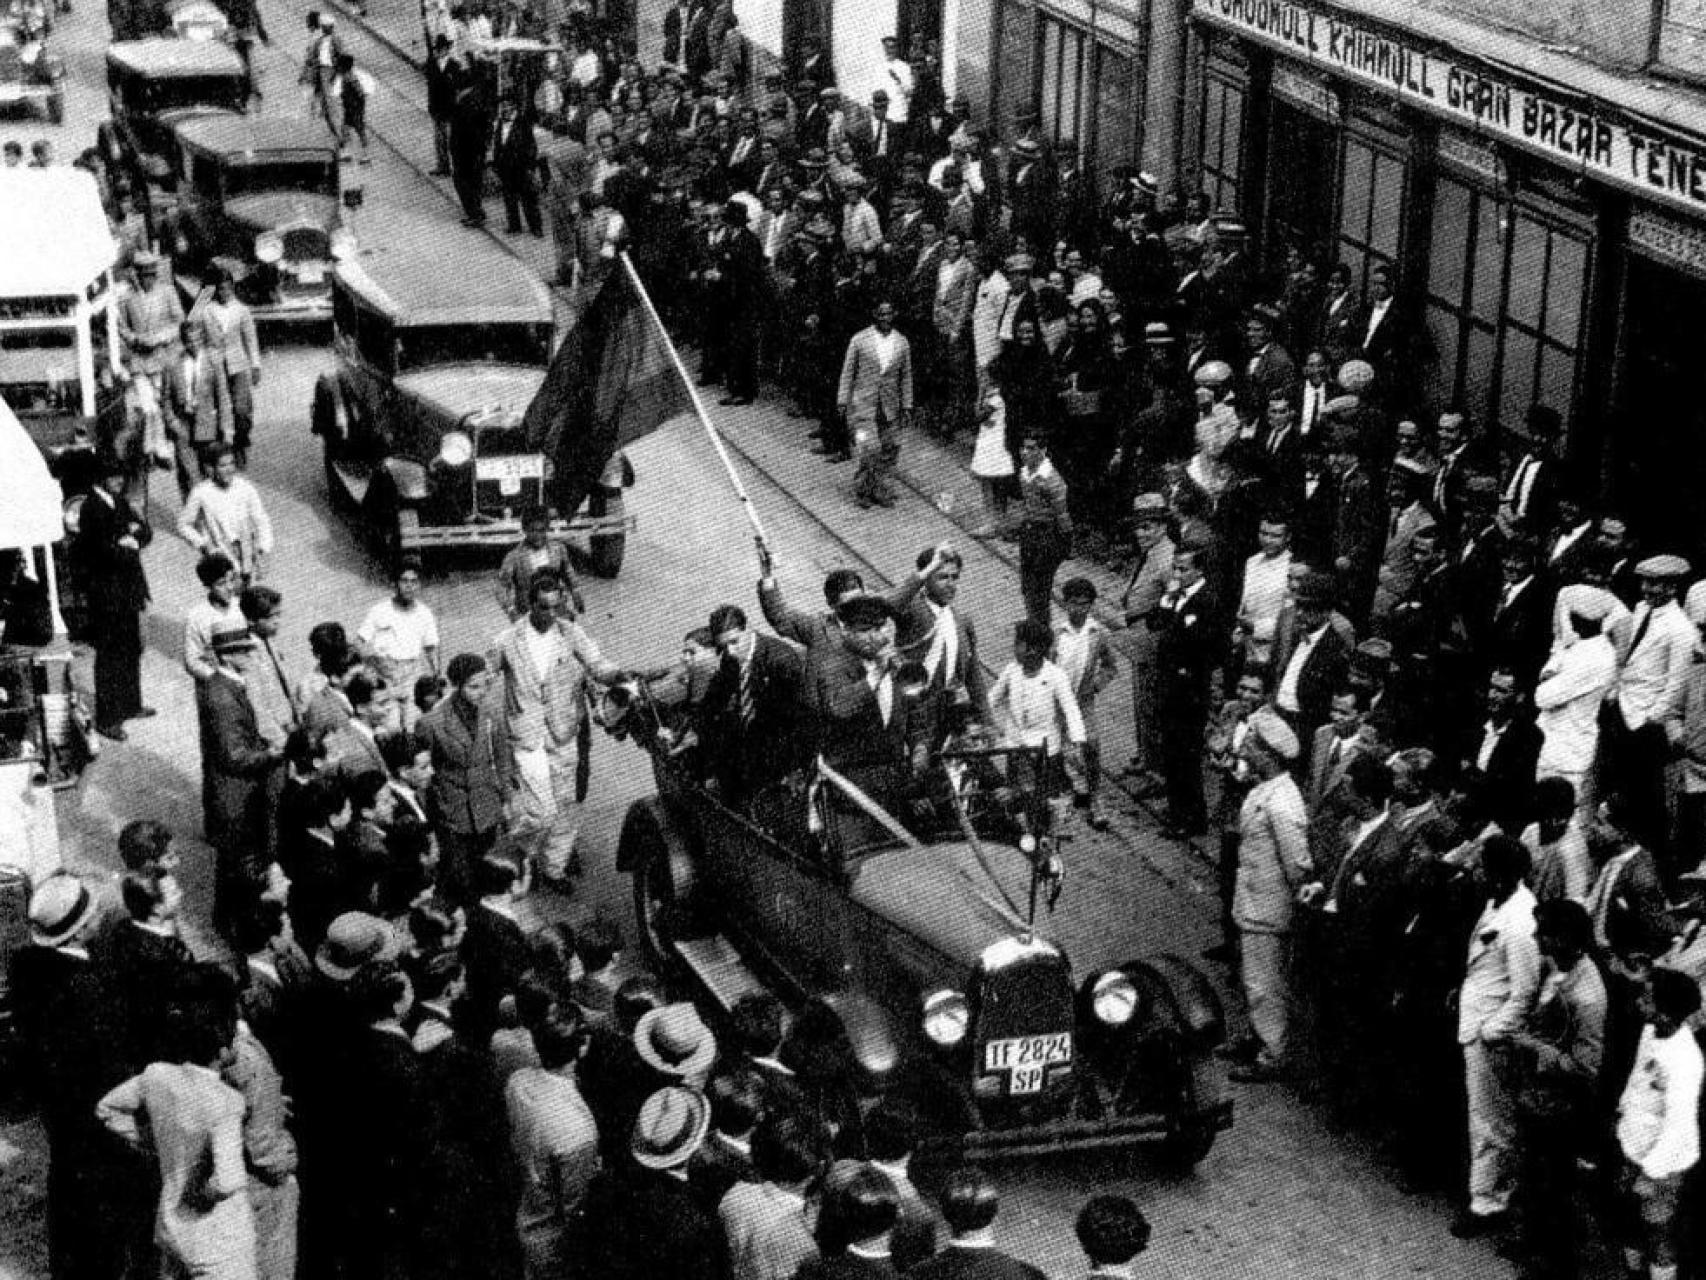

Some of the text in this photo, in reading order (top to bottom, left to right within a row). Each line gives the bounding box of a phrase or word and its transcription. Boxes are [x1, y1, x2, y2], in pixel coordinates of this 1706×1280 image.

[1448, 65, 1510, 128] GRAN
[1523, 95, 1612, 167] BAZAR
[992, 1036, 1067, 1066] TF 2824
[1014, 1070, 1041, 1091] SP
